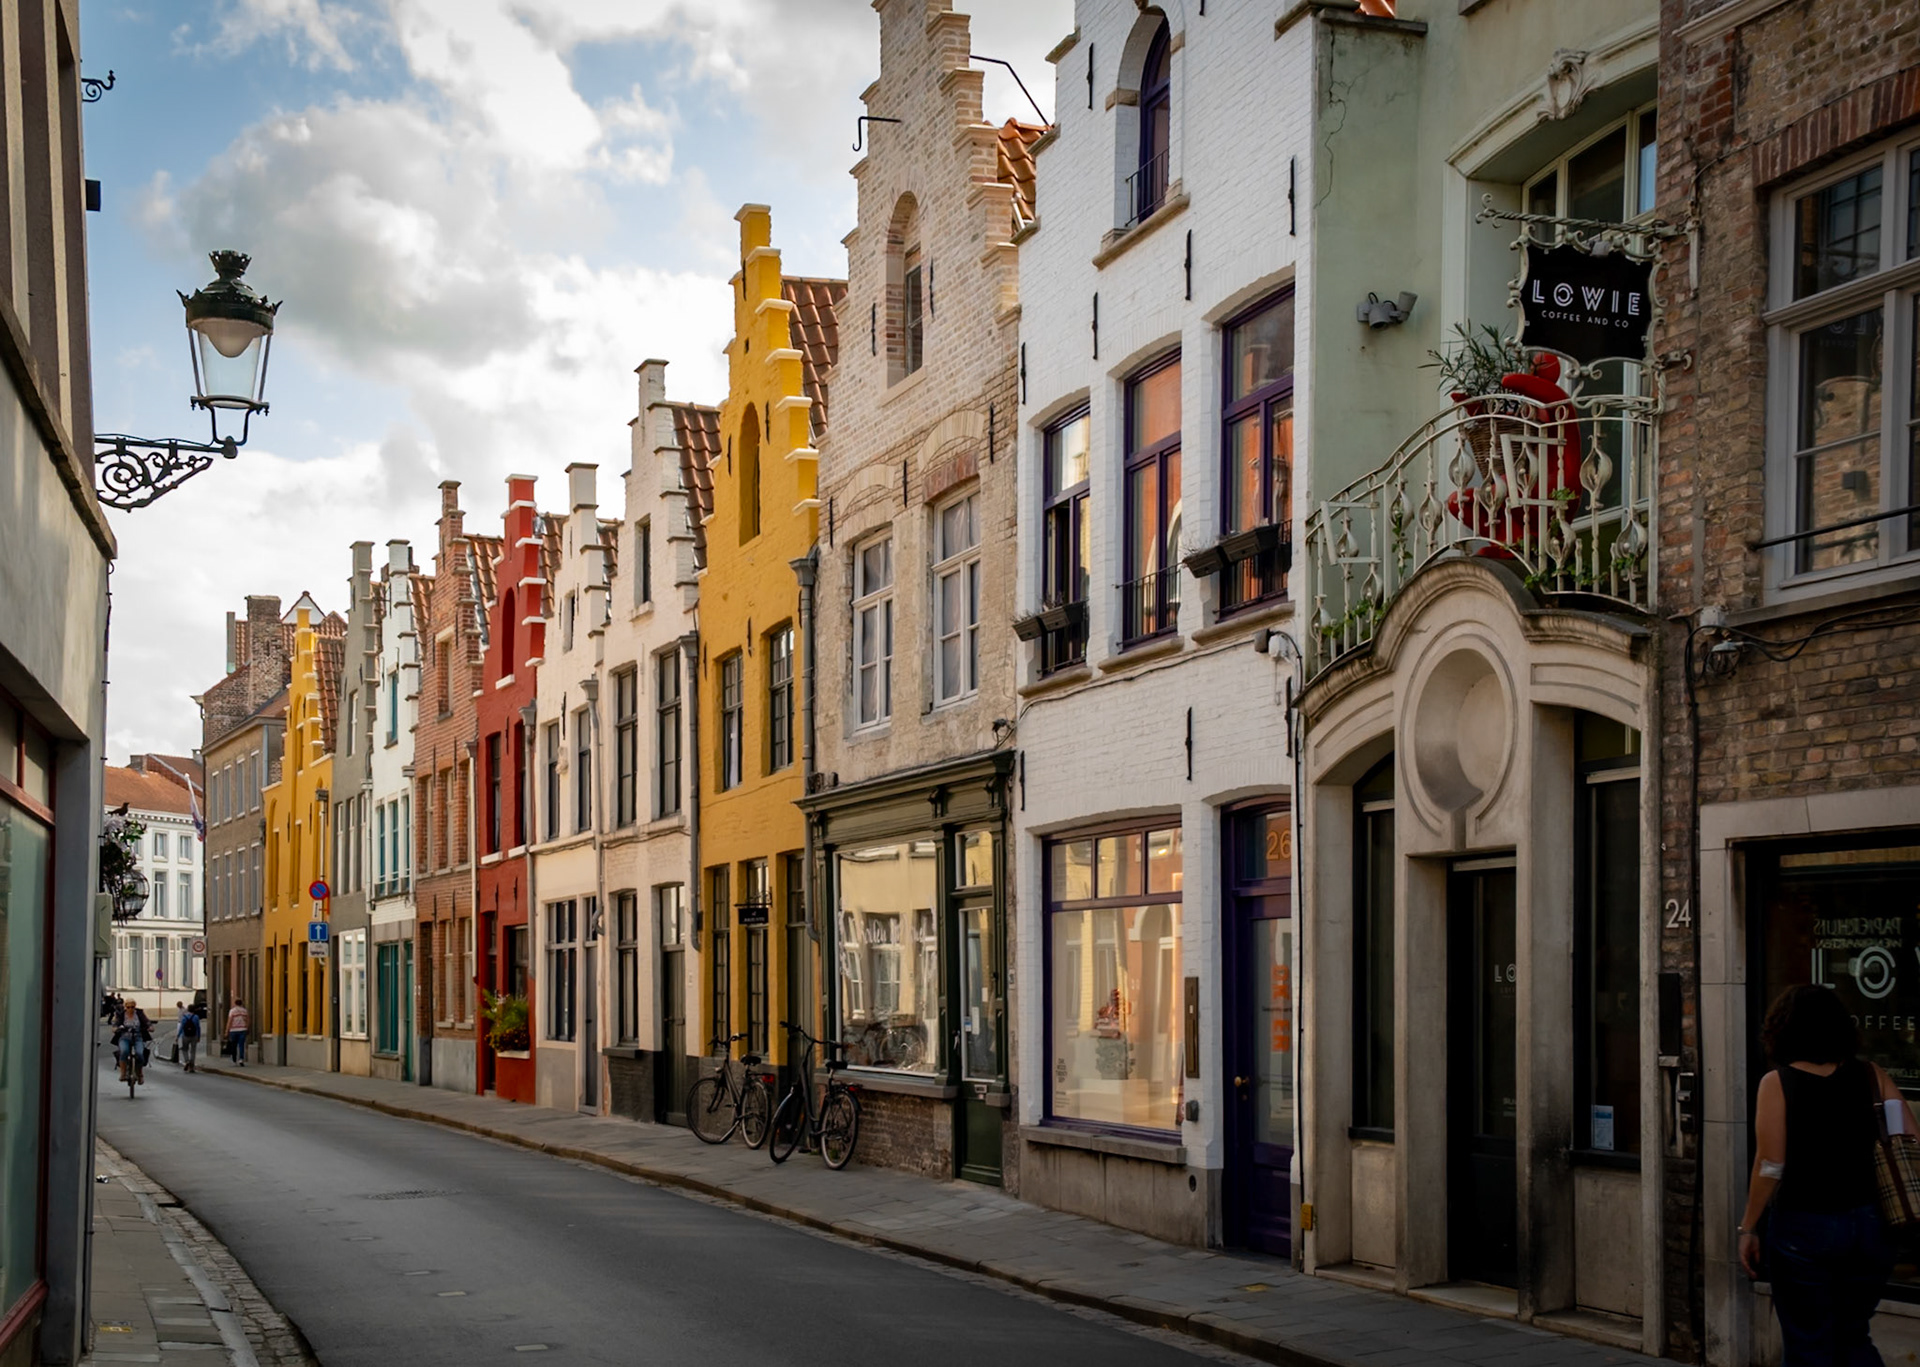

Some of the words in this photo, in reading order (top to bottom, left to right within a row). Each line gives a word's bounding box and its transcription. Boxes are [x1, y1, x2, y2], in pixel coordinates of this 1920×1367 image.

[1532, 279, 1641, 316] LOWIE
[1541, 309, 1581, 323] COFFEE
[1587, 315, 1609, 326] AND
[1614, 319, 1630, 329] CO
[1266, 828, 1291, 861] 26
[1664, 898, 1692, 930] 24
[1811, 946, 1920, 999] LO
